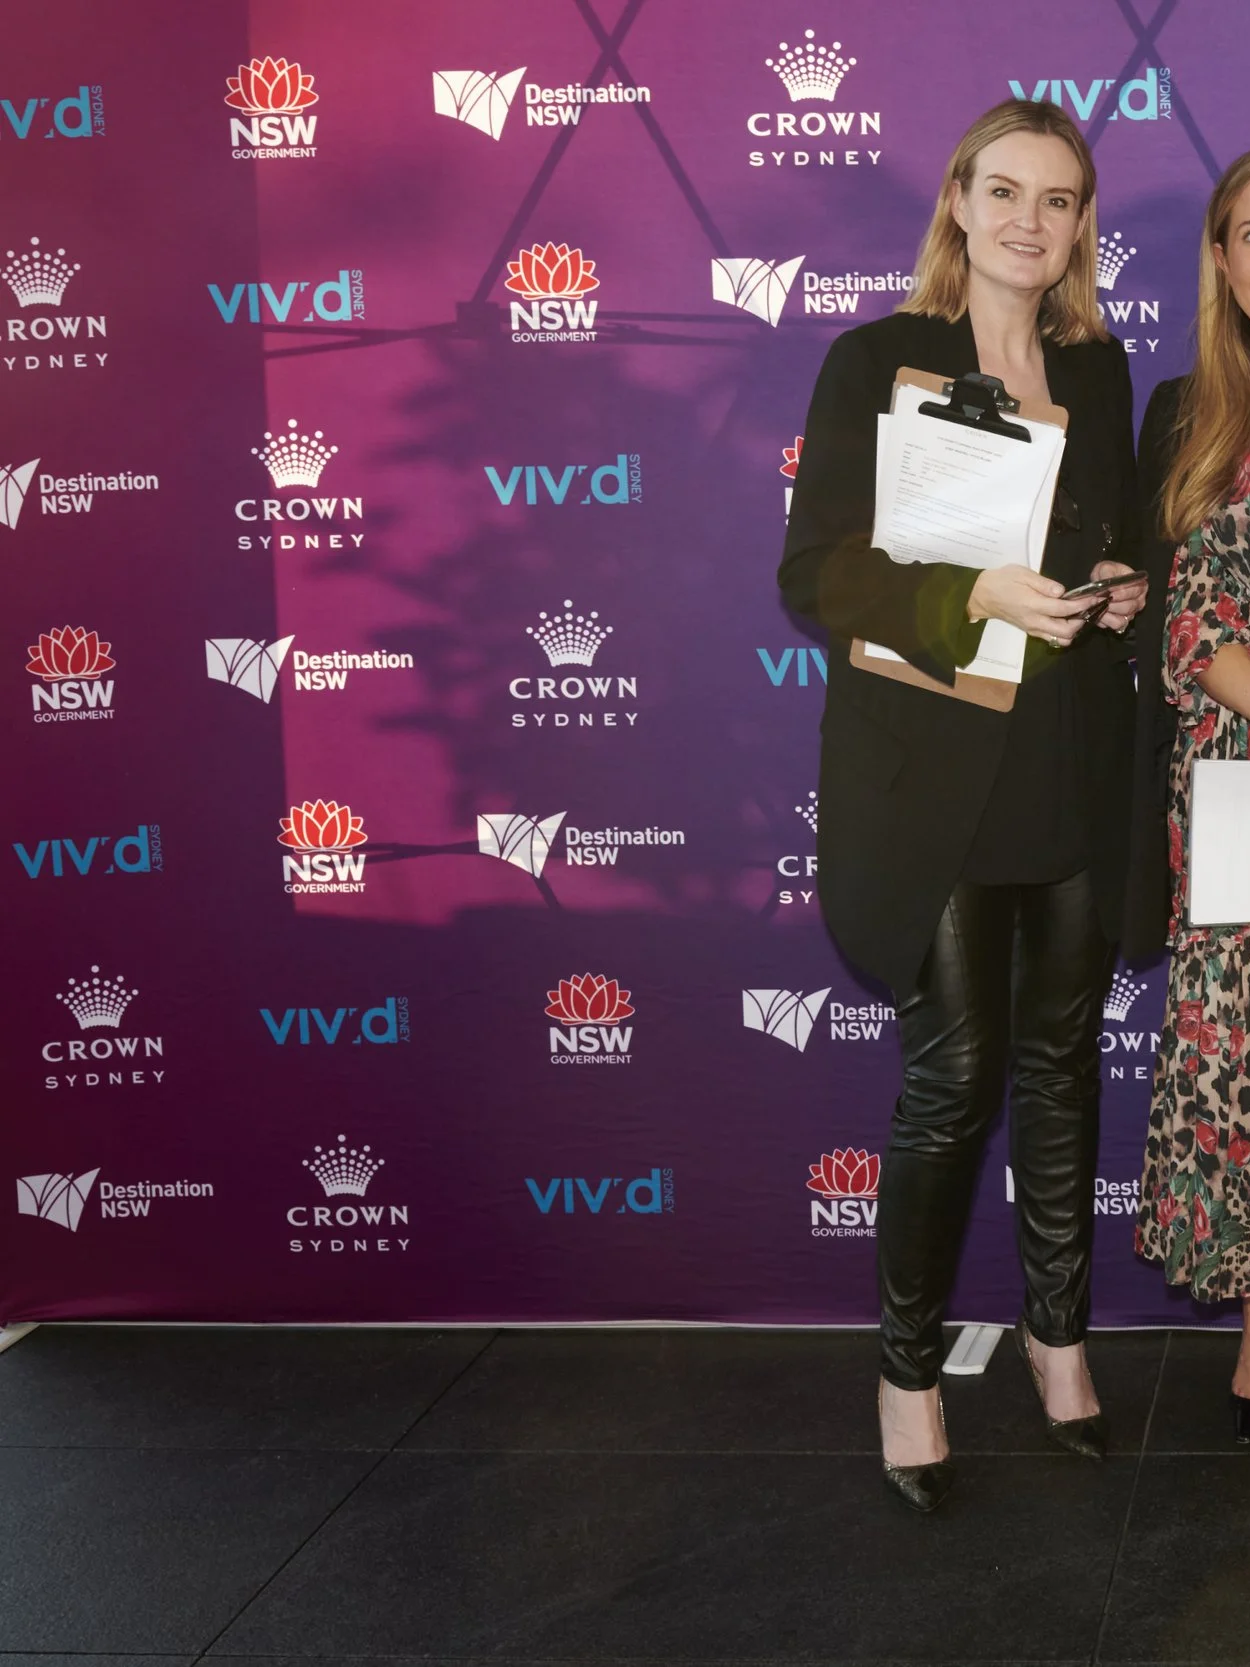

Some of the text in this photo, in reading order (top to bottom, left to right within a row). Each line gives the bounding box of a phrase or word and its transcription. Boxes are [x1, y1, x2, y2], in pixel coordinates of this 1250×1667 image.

[526, 83, 650, 104] Destination
[1160, 68, 1171, 119] SYDNEY
[91, 86, 104, 137] SYDNEY
[527, 106, 580, 126] NSW
[231, 117, 317, 144] NSW
[748, 112, 880, 136] CROWN
[232, 148, 317, 158] GOVERNMENT
[750, 151, 880, 166] SYDNEY
[804, 272, 915, 291] Destinatio
[351, 270, 364, 320] SYDNEY
[805, 294, 859, 313] NSW
[511, 301, 597, 330] NSW
[7, 316, 106, 341] ROWN
[512, 332, 597, 342] GOVERNMENT
[4, 354, 107, 370] YDNEY
[40, 472, 158, 493] Destination
[628, 455, 641, 503] SYDNEY
[42, 494, 92, 514] NSW
[236, 498, 362, 520] CROWN
[239, 534, 363, 549] SYDNEY
[294, 650, 413, 670] Destination
[295, 671, 347, 690] NSW
[510, 678, 636, 698] CROWN
[32, 680, 114, 709] NSW
[34, 710, 114, 722] GOVERNMENT
[512, 713, 637, 727] SYDNEY
[566, 827, 684, 845] Destination
[567, 847, 618, 865] NSW
[283, 854, 365, 881] NSW
[285, 883, 365, 893] GOVERNMENT
[399, 997, 409, 1041] SYDNEY
[831, 1003, 895, 1020] Destin
[550, 1027, 632, 1053] NSW
[831, 1023, 882, 1040] NSW
[42, 1037, 162, 1061] CROWN
[551, 1055, 631, 1064] GOVERNMENT
[46, 1071, 164, 1088] SYDNEY
[100, 1180, 213, 1199] Destination
[663, 1169, 674, 1212] SYDNEY
[102, 1200, 150, 1218] NSW
[287, 1206, 408, 1226] CROWN
[812, 1228, 876, 1236] GOVERNME
[290, 1239, 409, 1252] SYDNEY
